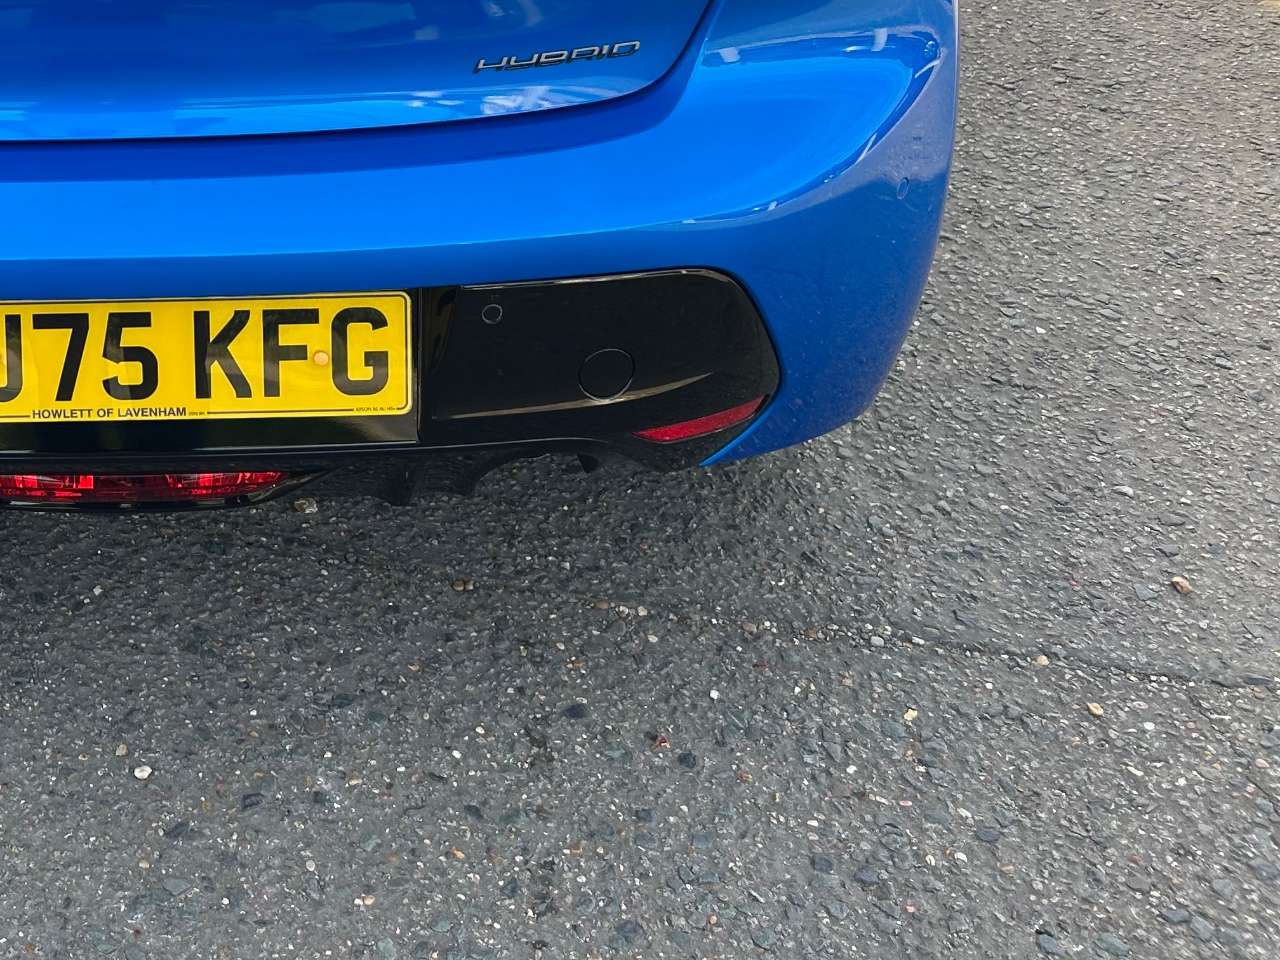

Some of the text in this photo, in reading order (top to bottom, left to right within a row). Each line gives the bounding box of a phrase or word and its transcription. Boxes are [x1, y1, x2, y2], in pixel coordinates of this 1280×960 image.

[473, 40, 641, 74] HYBRID
[193, 306, 389, 400] KFG
[32, 408, 93, 420] HOWLETT
[96, 407, 113, 419] OF
[117, 406, 187, 419] LAVENHAM
